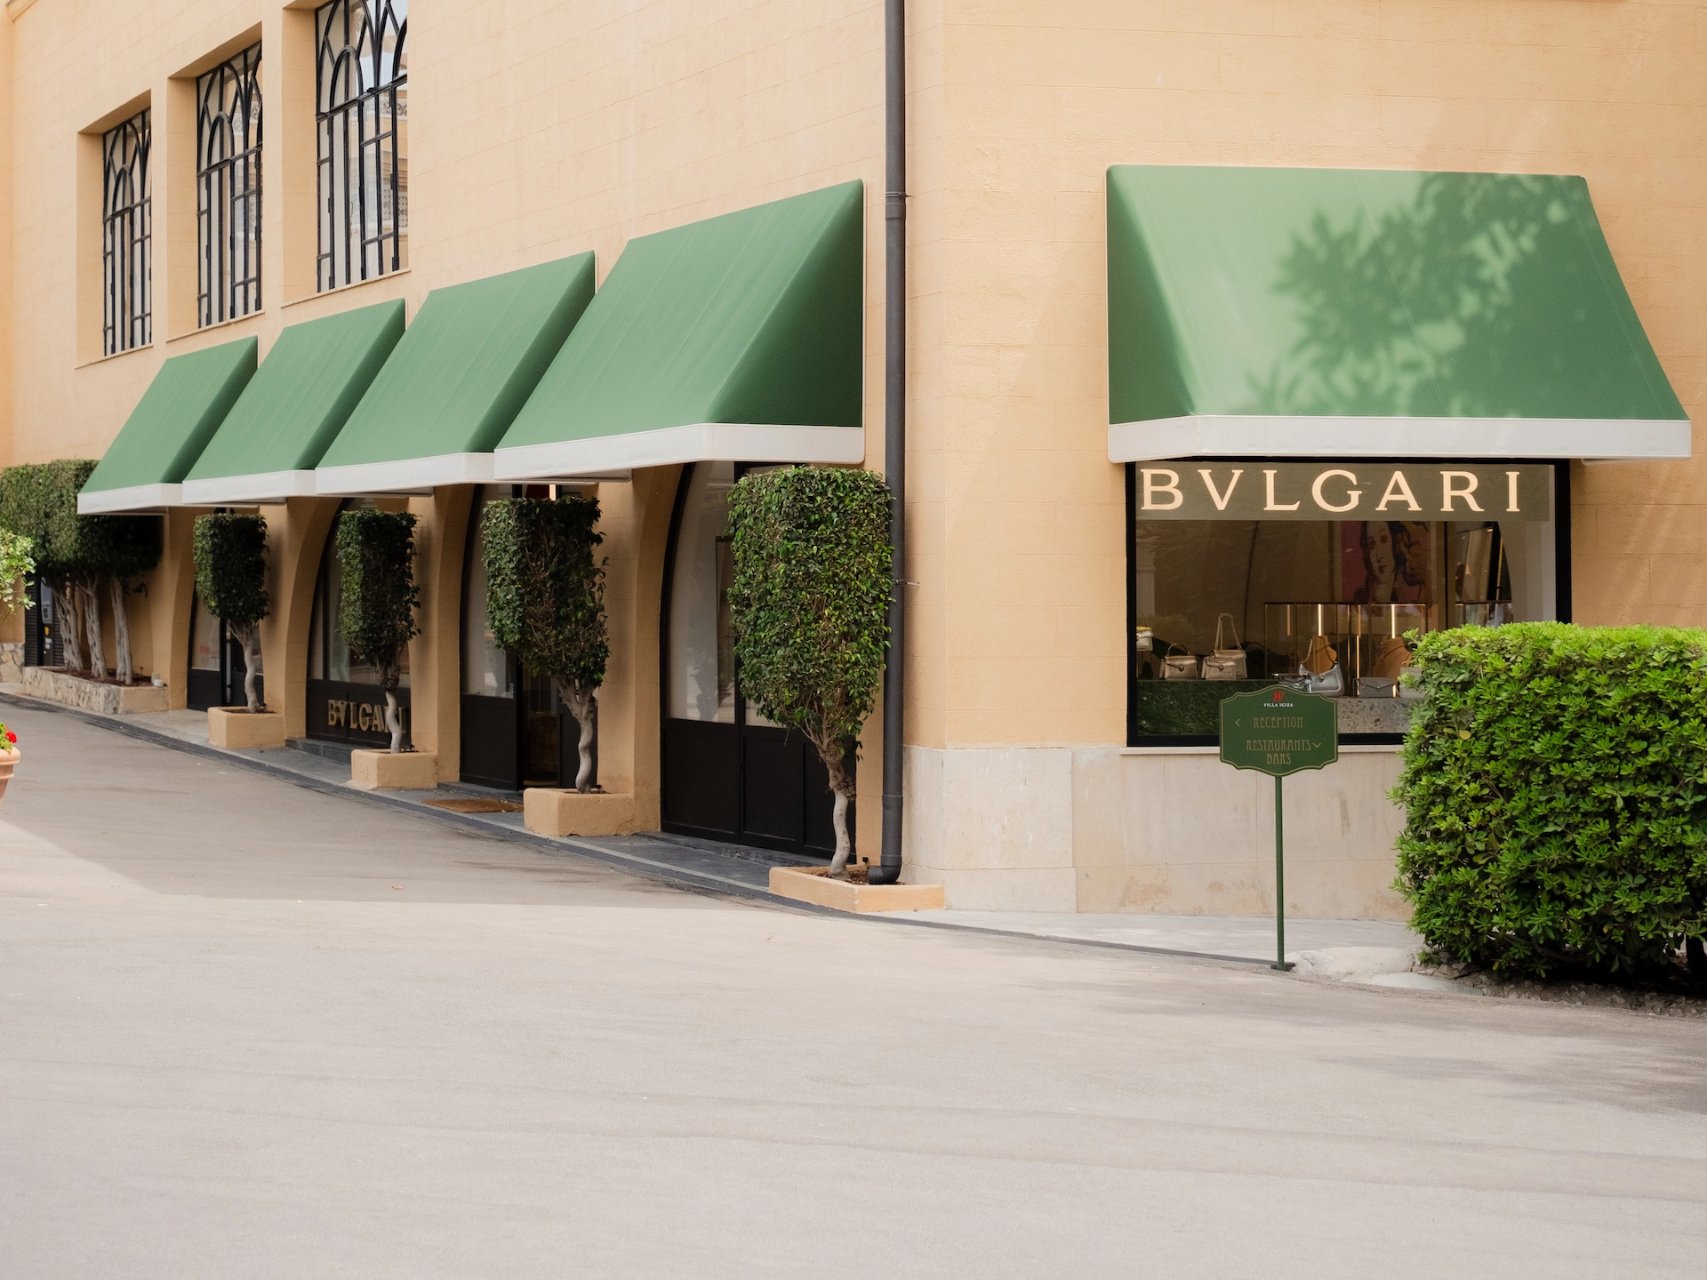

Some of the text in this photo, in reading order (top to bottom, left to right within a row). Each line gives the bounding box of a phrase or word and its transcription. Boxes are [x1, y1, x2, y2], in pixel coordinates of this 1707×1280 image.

[1140, 469, 1520, 513] BVLGARI
[1253, 716, 1303, 729] RECEPTION
[1246, 739, 1312, 751] RESTAURANTS
[1266, 753, 1292, 765] BARS
